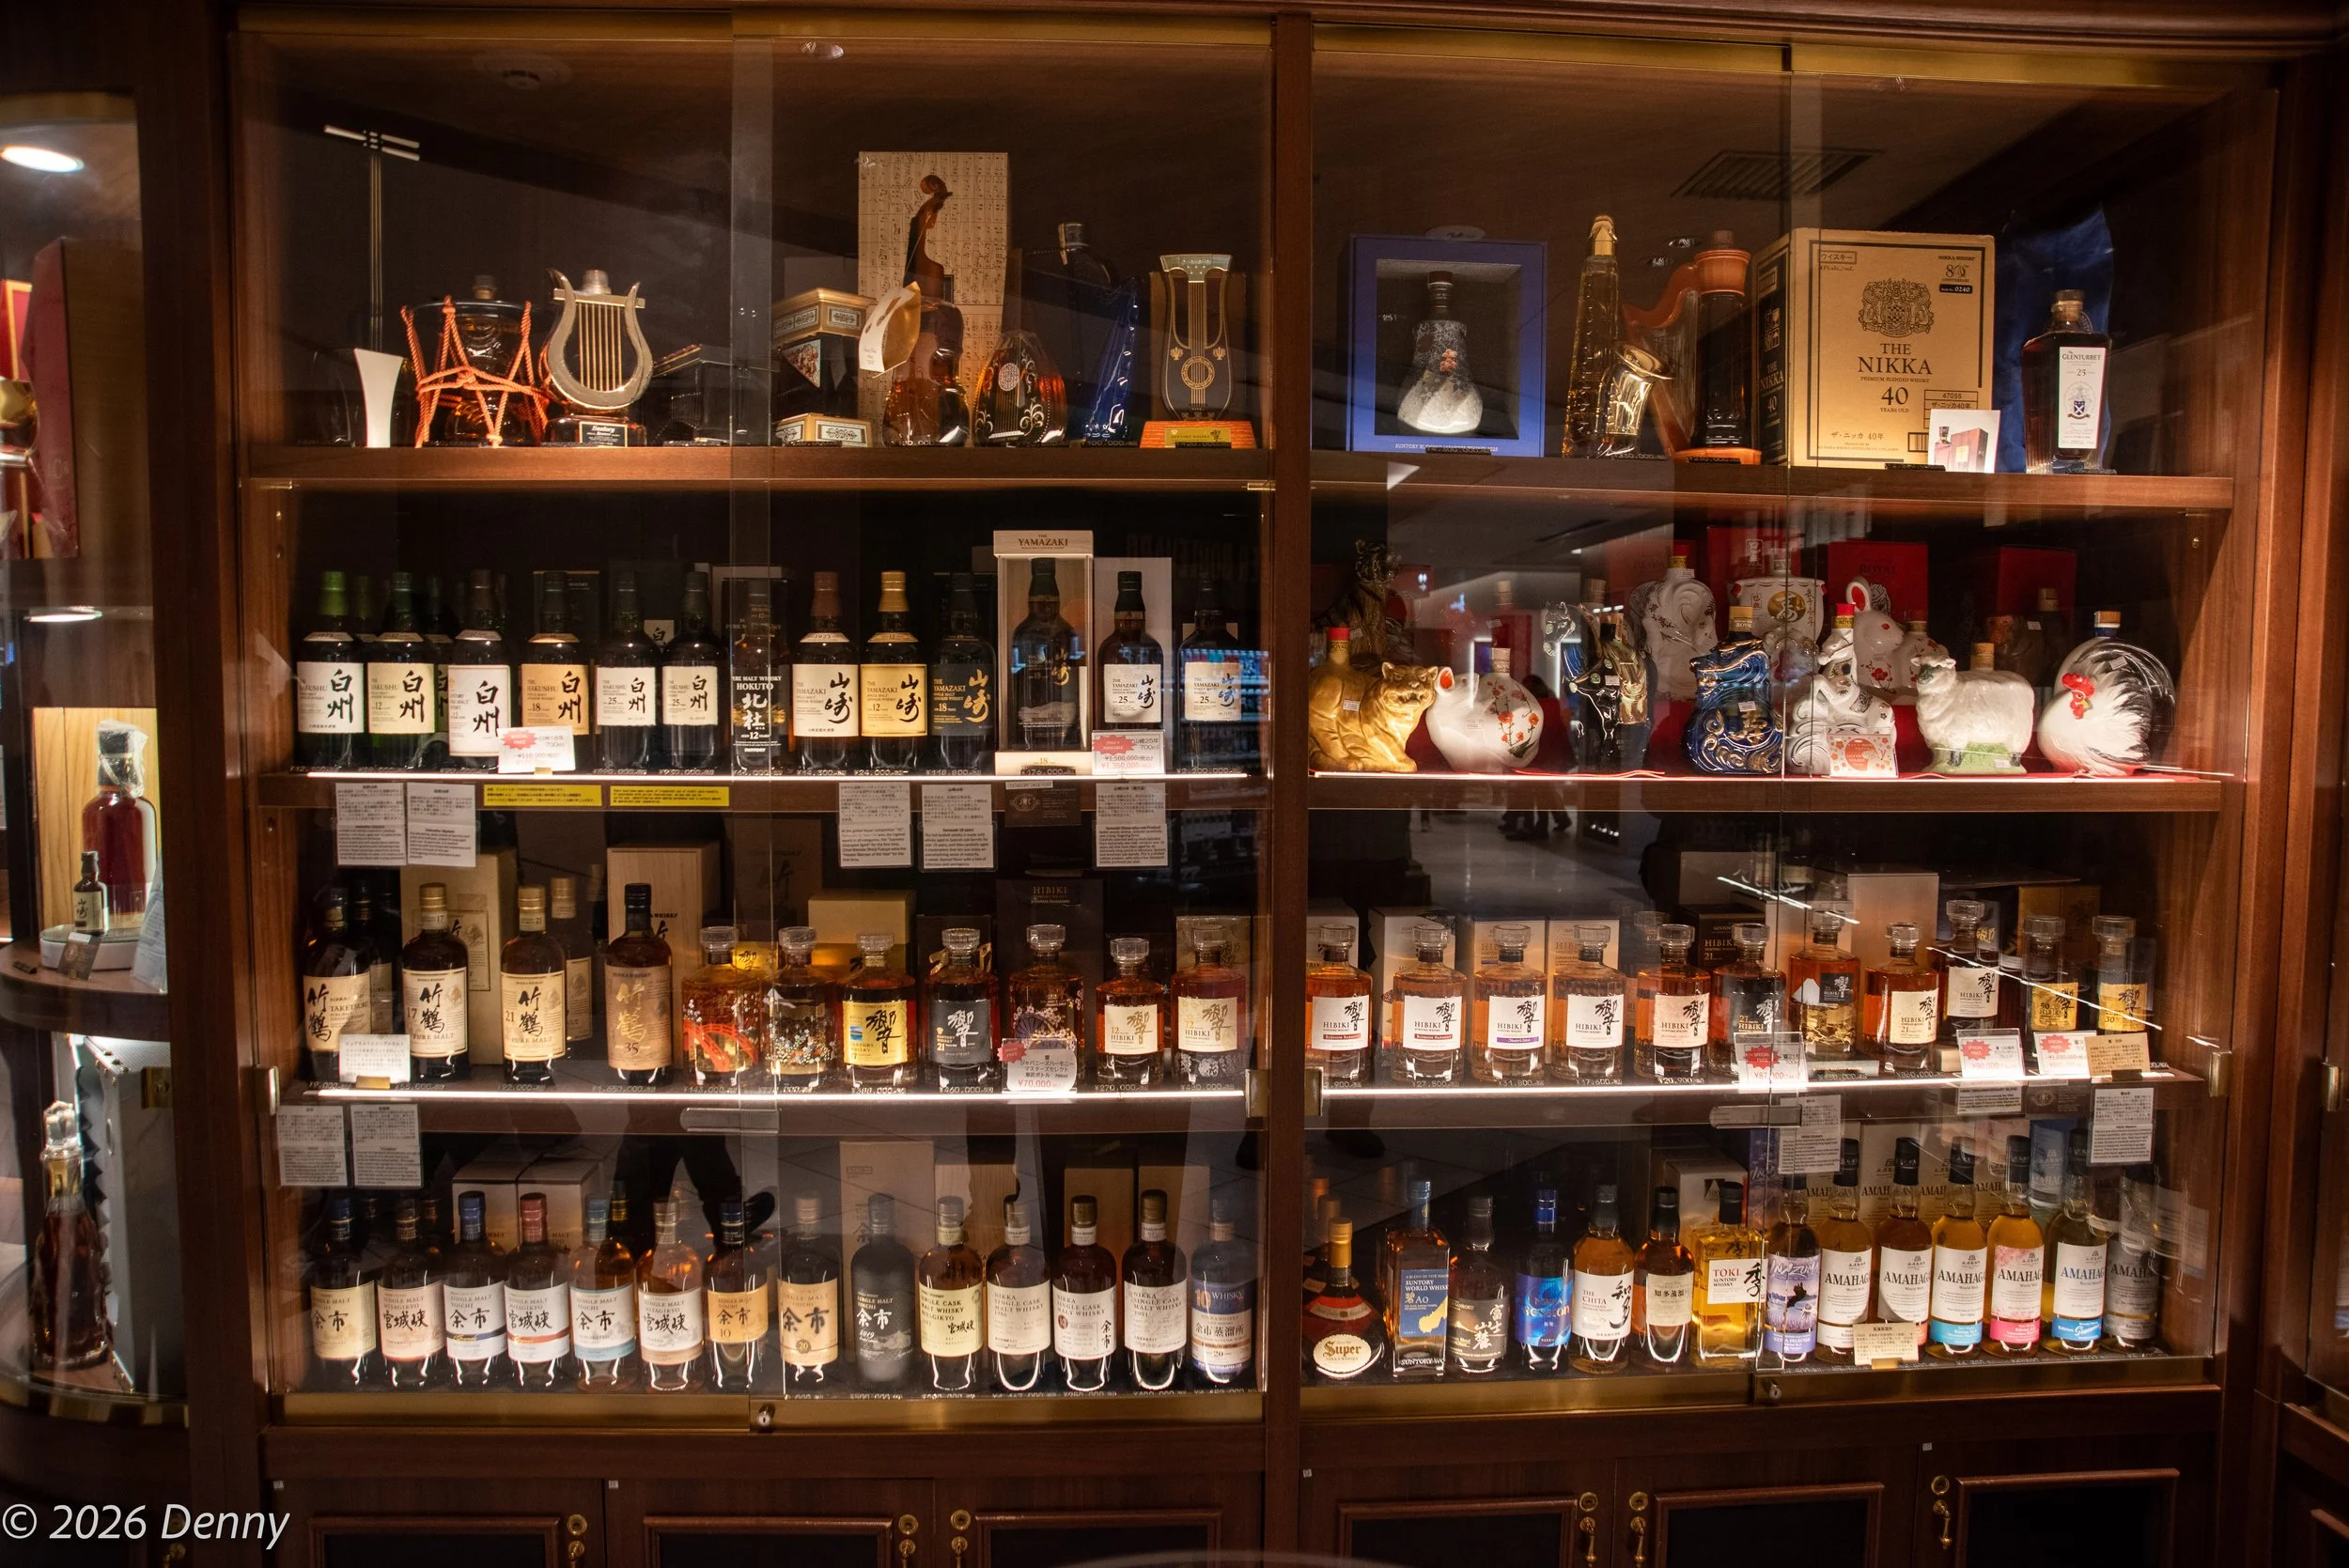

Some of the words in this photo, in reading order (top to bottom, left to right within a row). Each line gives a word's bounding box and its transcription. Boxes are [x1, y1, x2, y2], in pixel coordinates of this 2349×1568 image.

[1880, 343, 1911, 355] THE
[1858, 356, 1932, 375] NIKKA
[1760, 369, 1784, 391] NIKKA
[1767, 396, 1778, 412] 40
[1881, 386, 1908, 406] 40
[1867, 432, 1884, 441] 40年
[327, 668, 354, 723] 白州
[399, 670, 425, 722] 白州
[558, 671, 581, 723] 白州
[629, 677, 646, 713] 白州
[690, 675, 708, 711] 白州
[736, 682, 774, 691] HOKUTO
[824, 672, 852, 723] 山崎
[895, 674, 921, 722] 山崎
[963, 669, 990, 722] 山崎
[1137, 675, 1156, 708] 山崎
[1218, 673, 1236, 706] 山崎
[474, 680, 500, 737] 白州
[532, 703, 541, 711] 18
[741, 693, 768, 730] 北杜
[939, 703, 948, 711] 18
[1834, 976, 1850, 999] 響
[1978, 972, 1996, 1003] 響
[307, 983, 332, 1043] 竹鶴
[330, 1001, 369, 1012] TAKETSURU
[407, 1008, 417, 1019] 17
[419, 983, 444, 1033] 竹鶴
[505, 1010, 515, 1022] 21
[519, 986, 544, 1037] 竹鶴
[615, 981, 646, 1043] 竹鶴
[1345, 1001, 1364, 1032] 響
[1436, 1001, 1456, 1032] 響
[1920, 995, 1936, 1031] 響
[2119, 988, 2141, 1018] 響
[947, 1009, 979, 1048] 響
[1127, 1011, 1153, 1045] 響
[1185, 1020, 1194, 1029] 12
[1202, 1003, 1233, 1041] 響
[1517, 1001, 1539, 1033] 響
[1595, 999, 1619, 1035] 響
[1683, 1000, 1705, 1036] 響
[1739, 1015, 1749, 1023] 21
[865, 1009, 902, 1054] 響
[1185, 1029, 1210, 1037] HIBIKI
[624, 1042, 640, 1056] 35
[937, 1043, 945, 1051] 21
[1156, 1302, 1182, 1311] WHISKY
[1212, 1292, 1243, 1300] WHISKY
[1610, 1280, 1632, 1329] 知多
[314, 1311, 349, 1331] 余市
[383, 1310, 428, 1330] 宮城峡
[450, 1309, 490, 1328] 余市
[508, 1311, 552, 1331] 宮城峡
[576, 1311, 615, 1330] 余市
[644, 1313, 688, 1334] 宮城峡
[717, 1308, 751, 1325] 余市
[783, 1307, 830, 1334] 余市
[857, 1309, 892, 1329] 余市
[1472, 1304, 1504, 1350] 富士山麓
[720, 1329, 732, 1338] 10
[1101, 1320, 1112, 1348] 余市
[1195, 1324, 1244, 1337] 余市蒸溜所
[1323, 1341, 1361, 1358] Super
